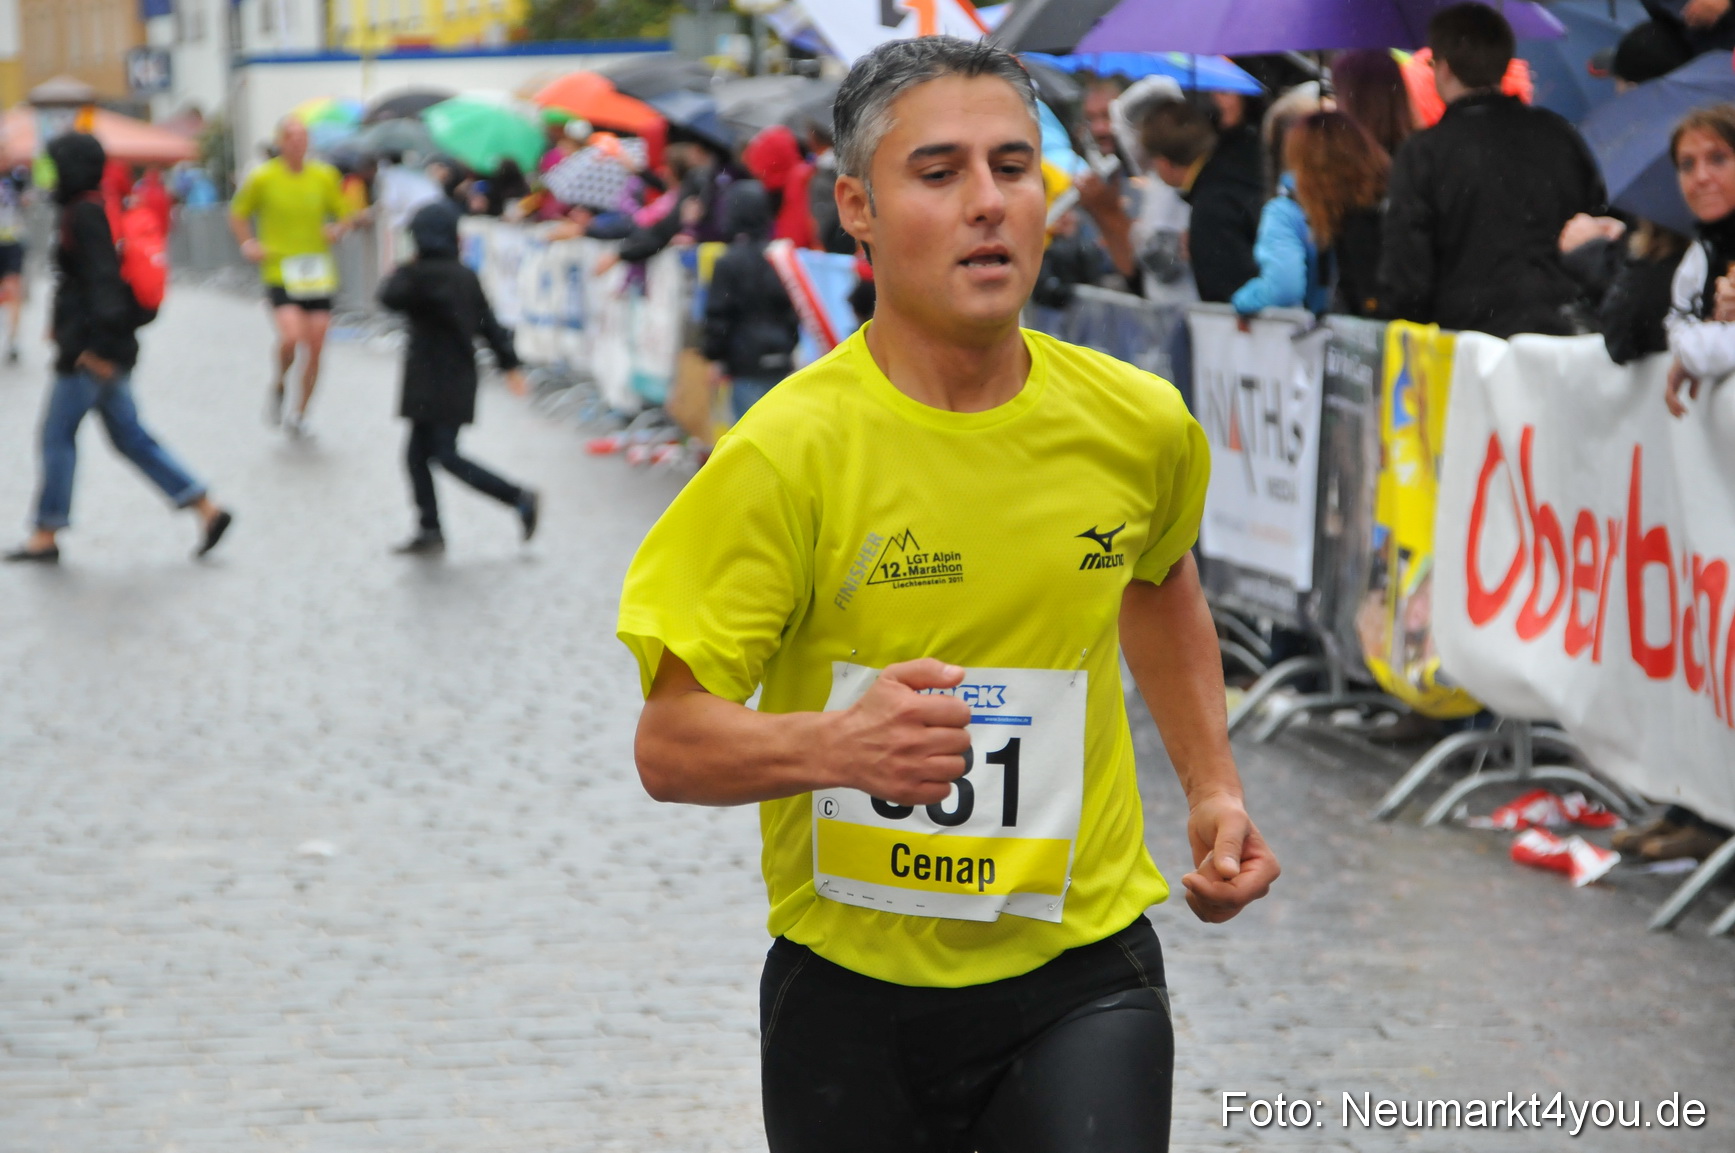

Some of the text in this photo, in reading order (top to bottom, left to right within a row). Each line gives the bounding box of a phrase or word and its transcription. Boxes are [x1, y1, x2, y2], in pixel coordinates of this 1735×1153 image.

[834, 532, 883, 611] FINISHER
[880, 562, 962, 579] 12. Marathon
[893, 576, 964, 589] Liechtenstein 2011
[906, 551, 961, 565] LGT Alpin
[1466, 424, 1735, 729] Oberban
[871, 737, 1021, 827] 81
[891, 843, 995, 892] Cenap
